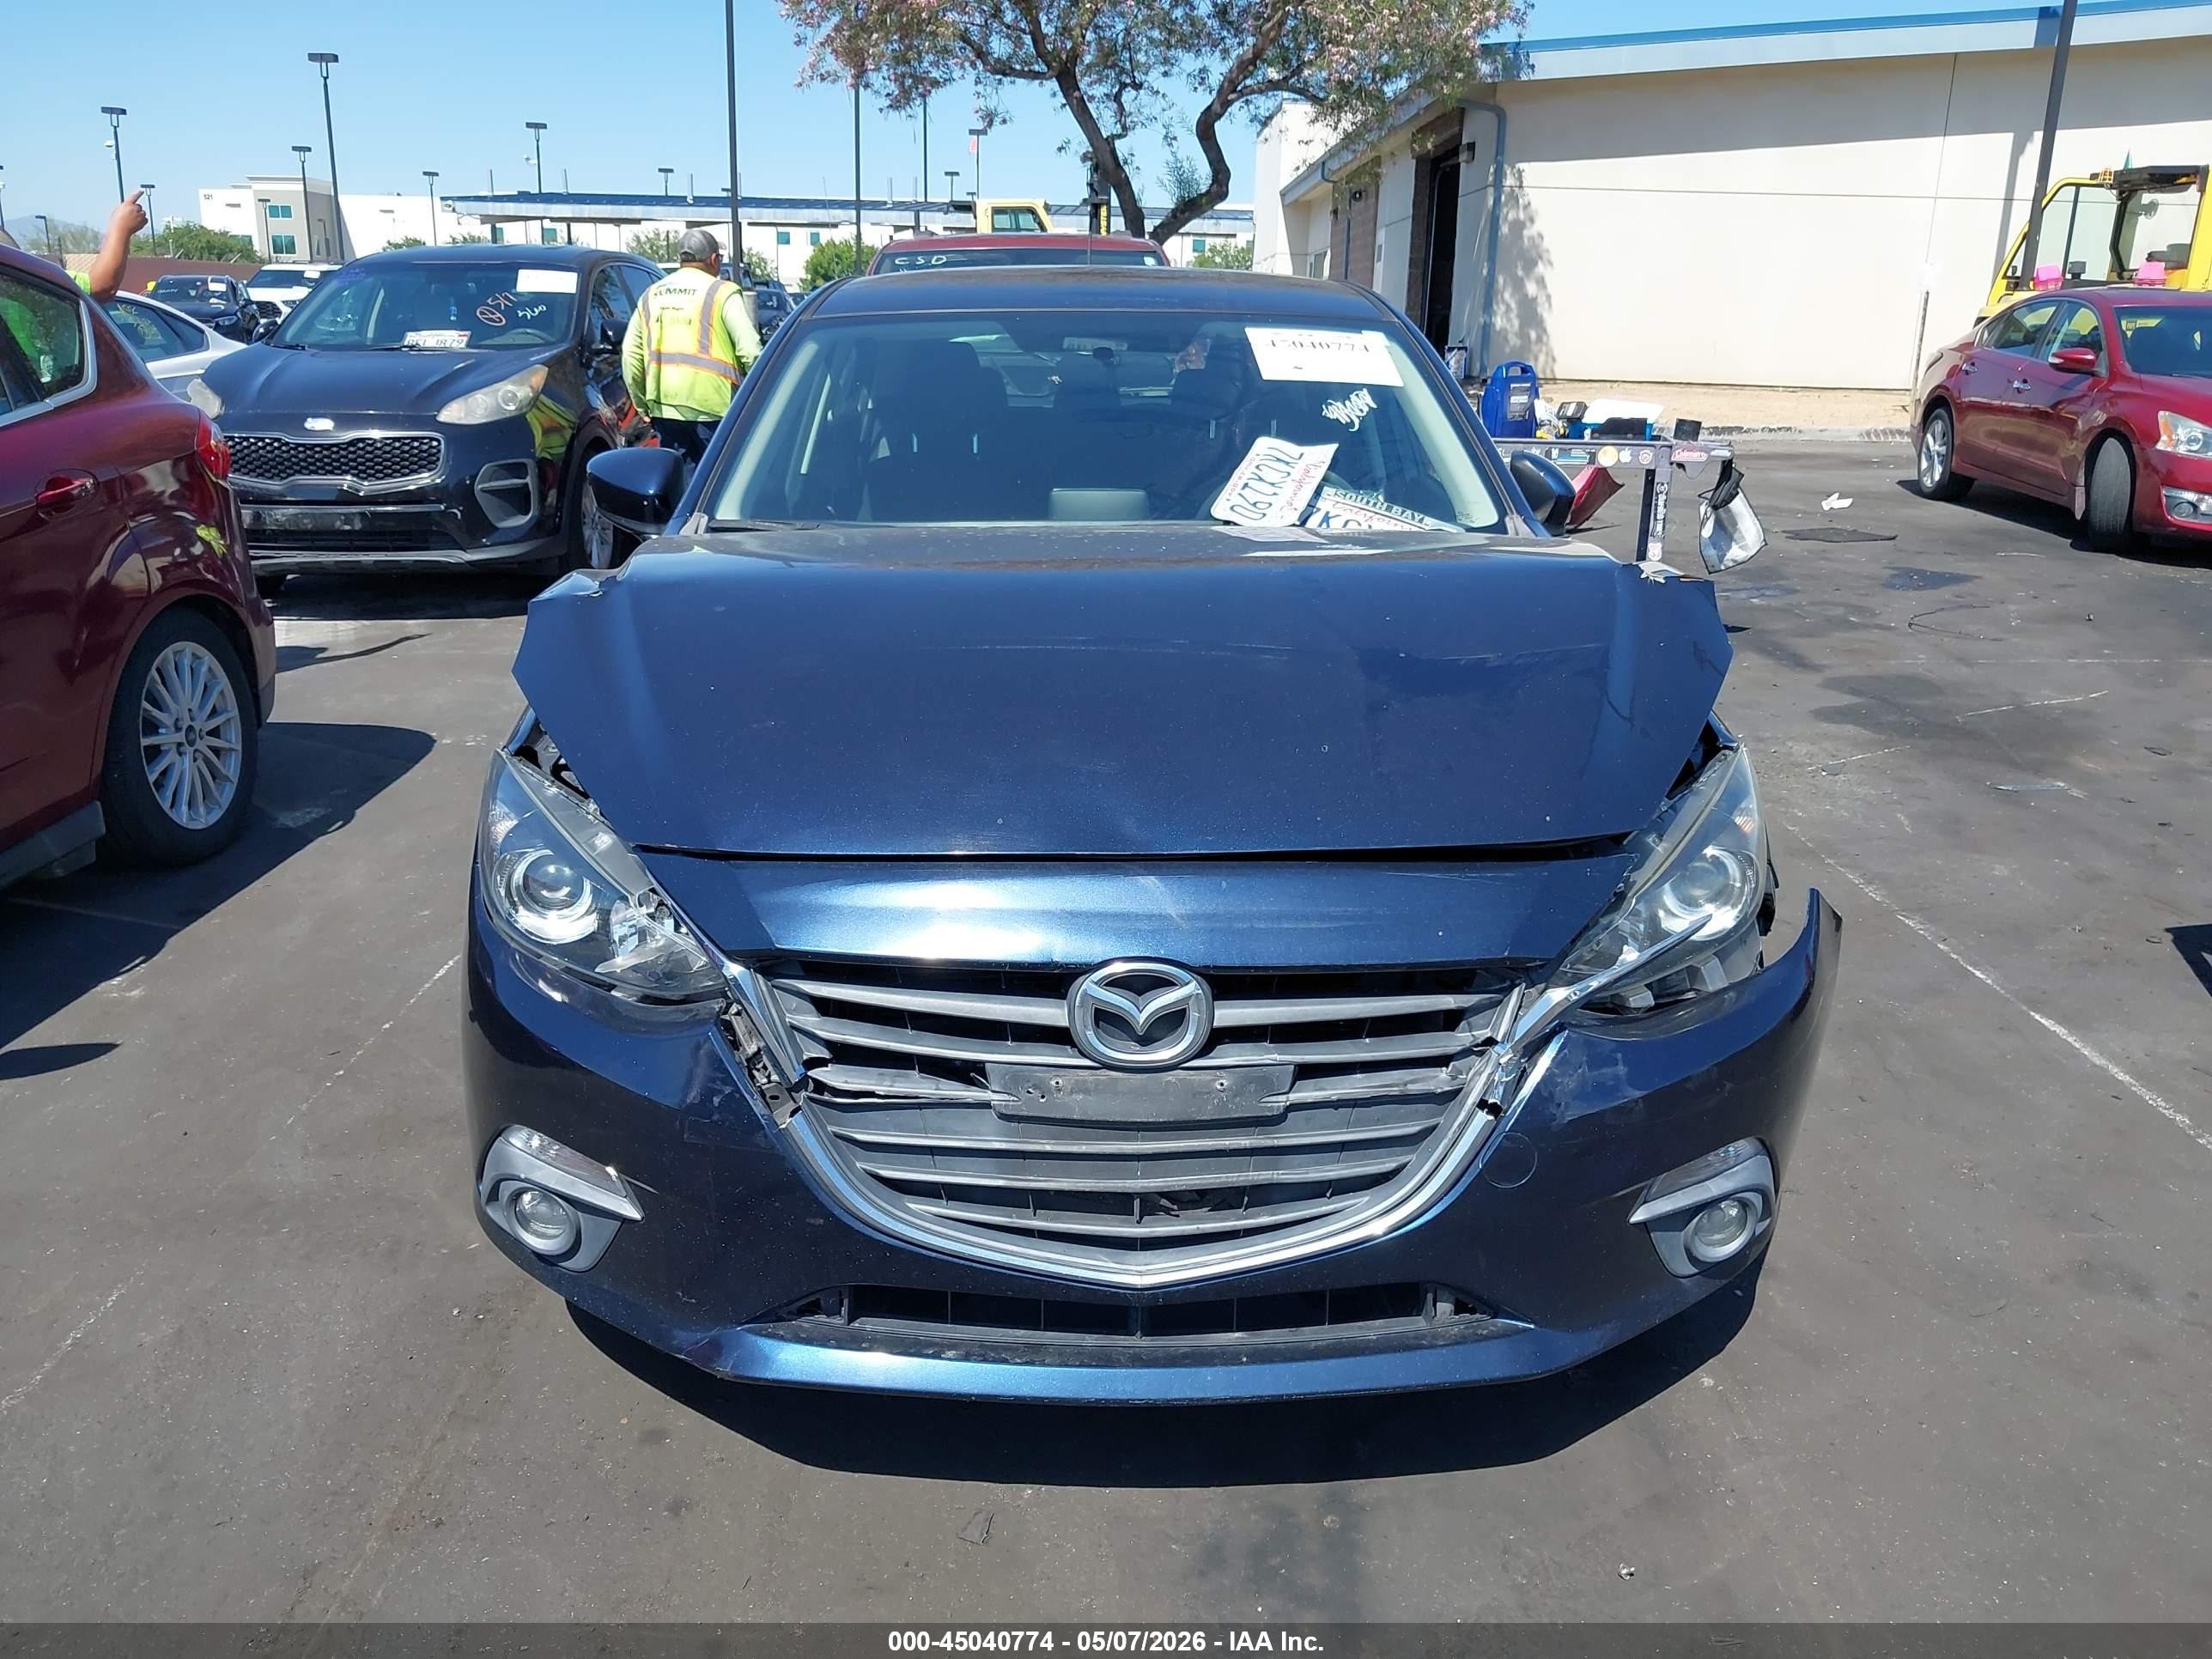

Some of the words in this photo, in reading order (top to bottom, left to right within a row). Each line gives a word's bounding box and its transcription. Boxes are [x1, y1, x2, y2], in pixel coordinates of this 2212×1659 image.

[1229, 446, 1304, 521] 7KCX190
[1336, 490, 1388, 512] SOUTH
[1387, 503, 1425, 524] BAY
